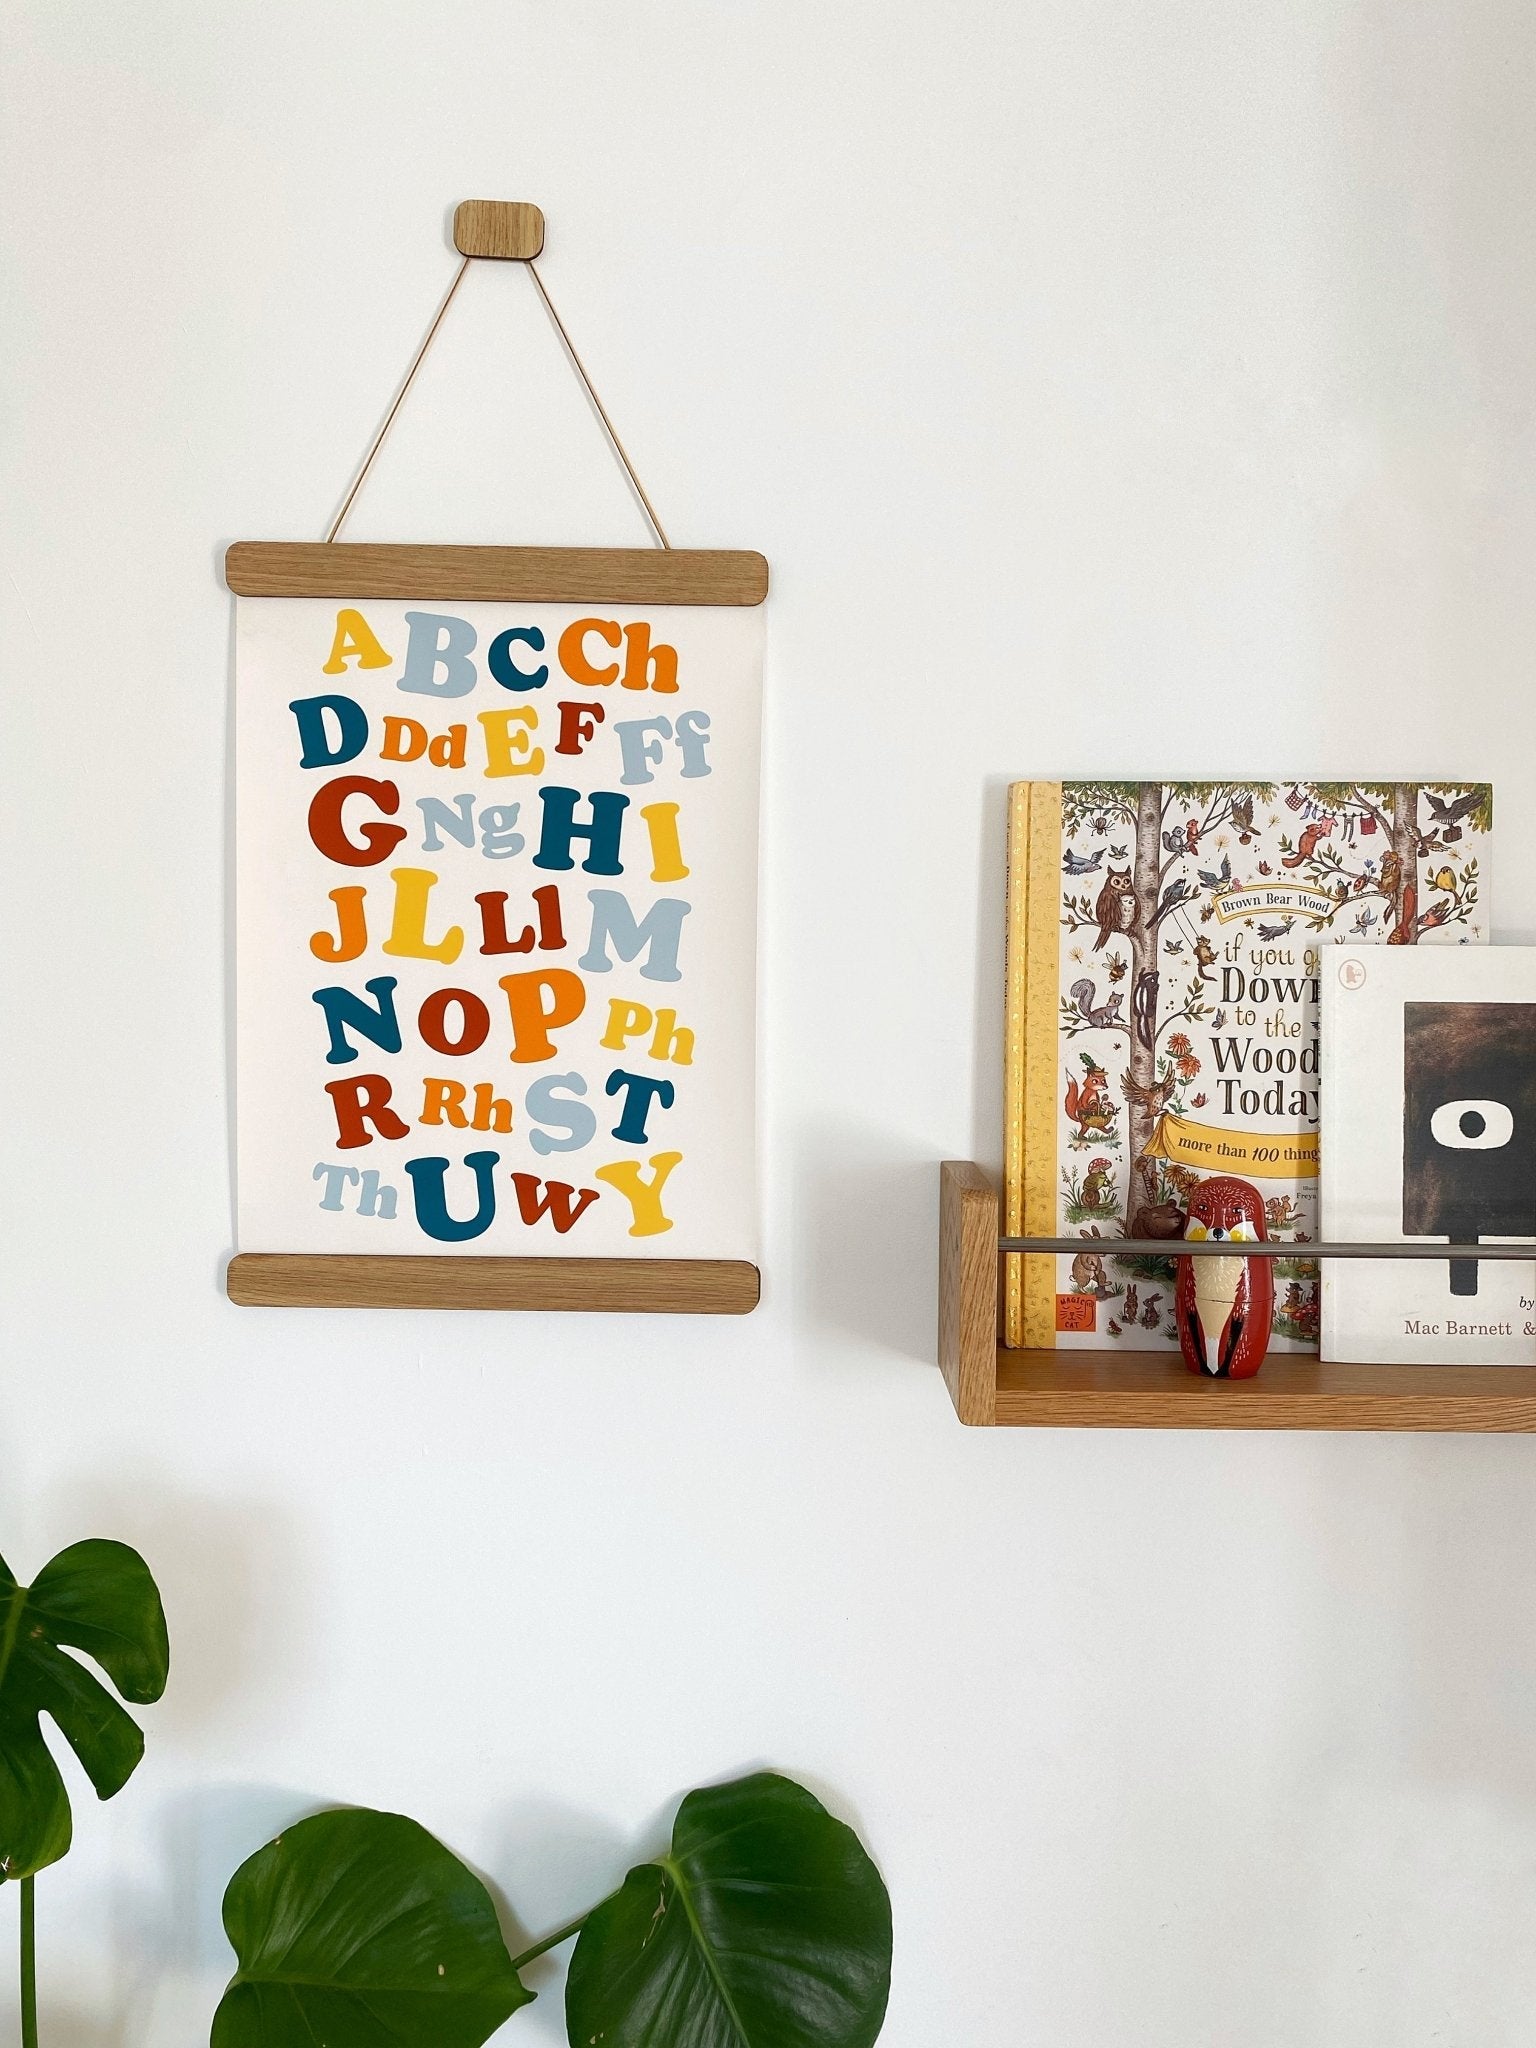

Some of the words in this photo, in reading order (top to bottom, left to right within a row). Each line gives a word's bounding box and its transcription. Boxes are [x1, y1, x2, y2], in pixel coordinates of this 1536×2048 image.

[322, 609, 393, 675] A
[397, 612, 477, 698] B
[488, 626, 549, 692] C
[558, 618, 679, 694] Ch
[289, 695, 369, 769] D
[379, 716, 467, 769] Dd
[477, 705, 545, 778] E
[555, 701, 605, 755] F
[614, 711, 712, 785] Ff
[308, 775, 407, 867] G
[416, 794, 525, 859] Ng
[532, 786, 630, 876] H
[640, 802, 690, 883] I
[1221, 895, 1261, 913] Brown
[1266, 892, 1292, 905] Bear
[1298, 894, 1331, 913] Wood
[309, 886, 368, 963] J
[382, 867, 464, 965] L
[474, 884, 567, 955] Ll
[578, 889, 691, 982] M
[1224, 932, 1244, 962] if
[1249, 949, 1295, 976] you
[1303, 949, 1318, 976] g
[312, 976, 402, 1064] N
[418, 988, 490, 1056] O
[498, 968, 586, 1063] P
[600, 998, 695, 1065] Ph
[1235, 1006, 1257, 1026] to
[1264, 1008, 1302, 1038] the
[1209, 1037, 1318, 1074] Wood
[324, 1074, 410, 1149] R
[418, 1078, 513, 1133] Rh
[525, 1072, 596, 1155] S
[605, 1069, 674, 1144] T
[1178, 1136, 1212, 1153] more
[1217, 1142, 1247, 1158] than
[1251, 1147, 1280, 1162] 100
[1284, 1148, 1319, 1162] thing
[313, 1162, 397, 1219] Th
[404, 1151, 500, 1242] U
[595, 1151, 683, 1237] Y
[1296, 1192, 1317, 1201] Freya
[1060, 1296, 1085, 1306] MAGIC
[1519, 1296, 1535, 1310] by
[1064, 1321, 1080, 1329] CAT
[1404, 1320, 1440, 1335] Mac
[1446, 1320, 1513, 1336] Barnett
[1523, 1321, 1536, 1336] &
